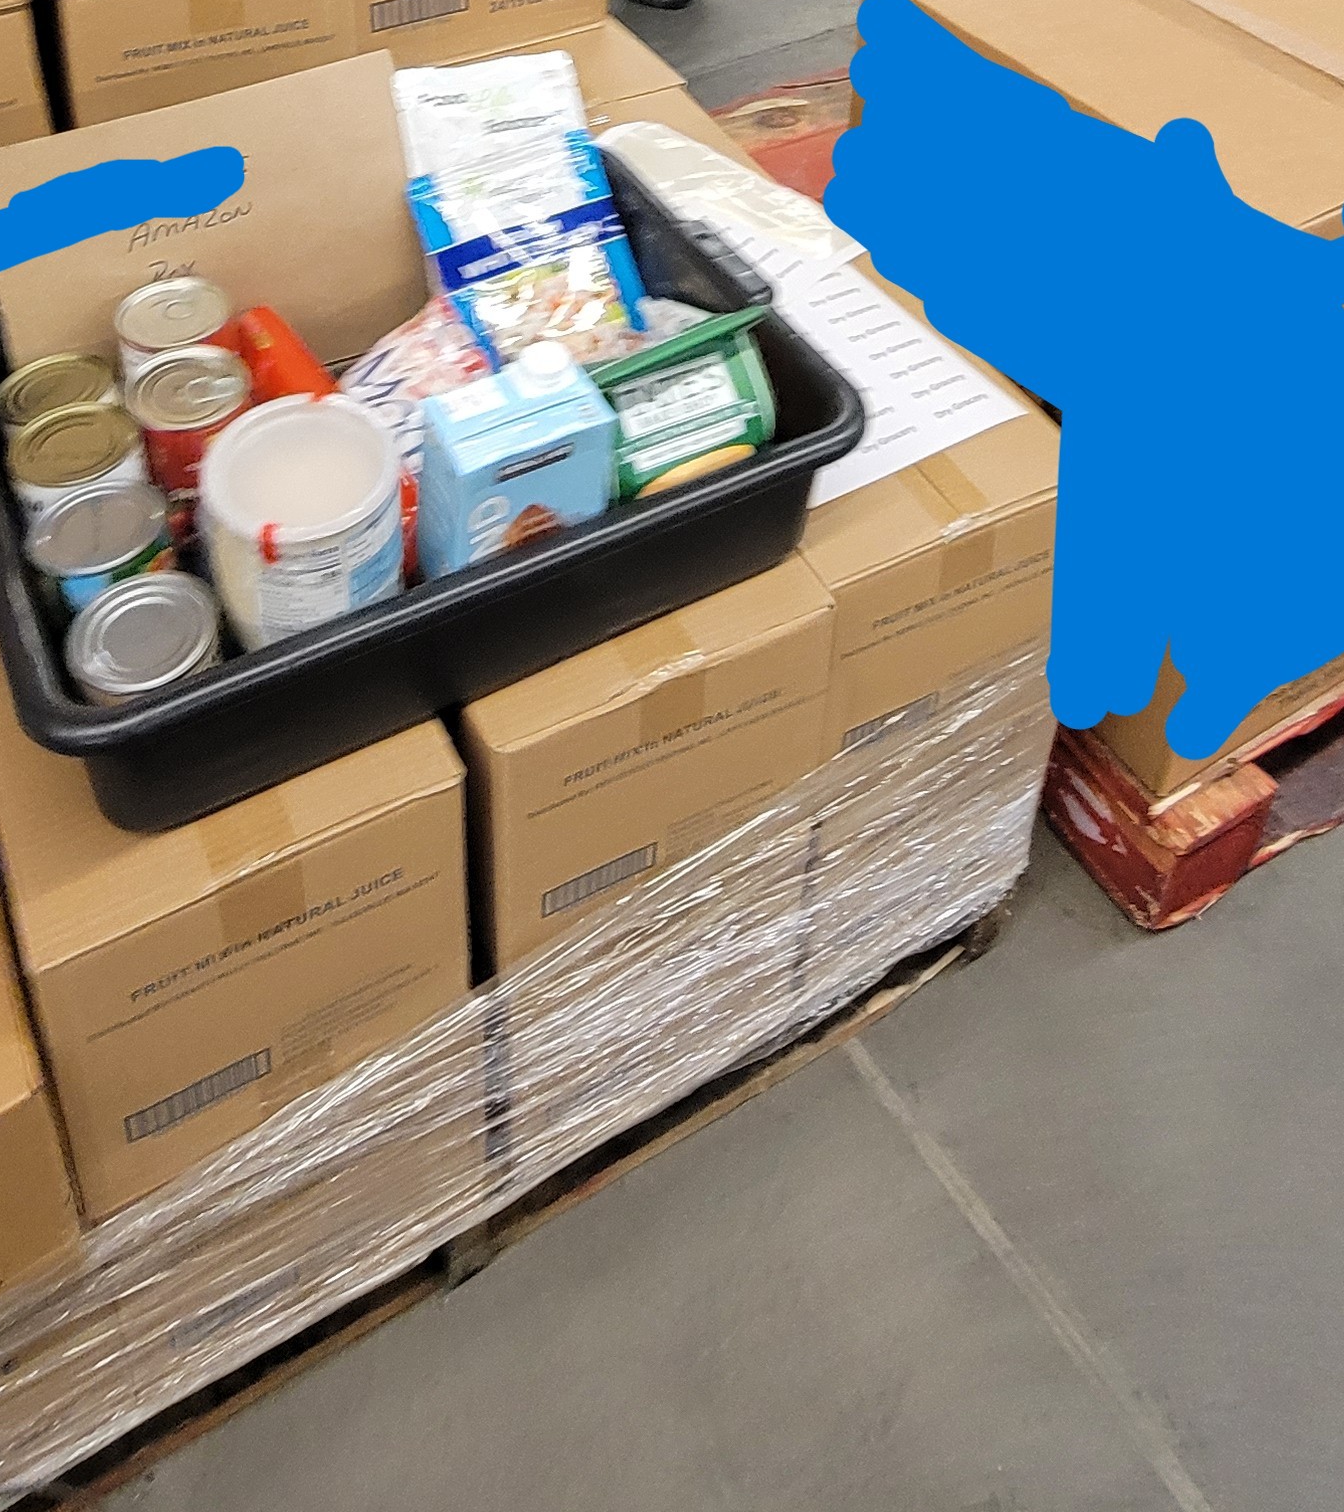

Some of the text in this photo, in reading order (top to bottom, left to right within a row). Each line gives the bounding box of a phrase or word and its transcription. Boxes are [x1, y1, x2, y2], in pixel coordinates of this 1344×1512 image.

[563, 760, 609, 787] FRUIT
[662, 709, 733, 744] NATURAL
[130, 967, 190, 1002] FRUIT
[257, 899, 345, 944] NATURAL
[350, 867, 404, 900] JUICE
